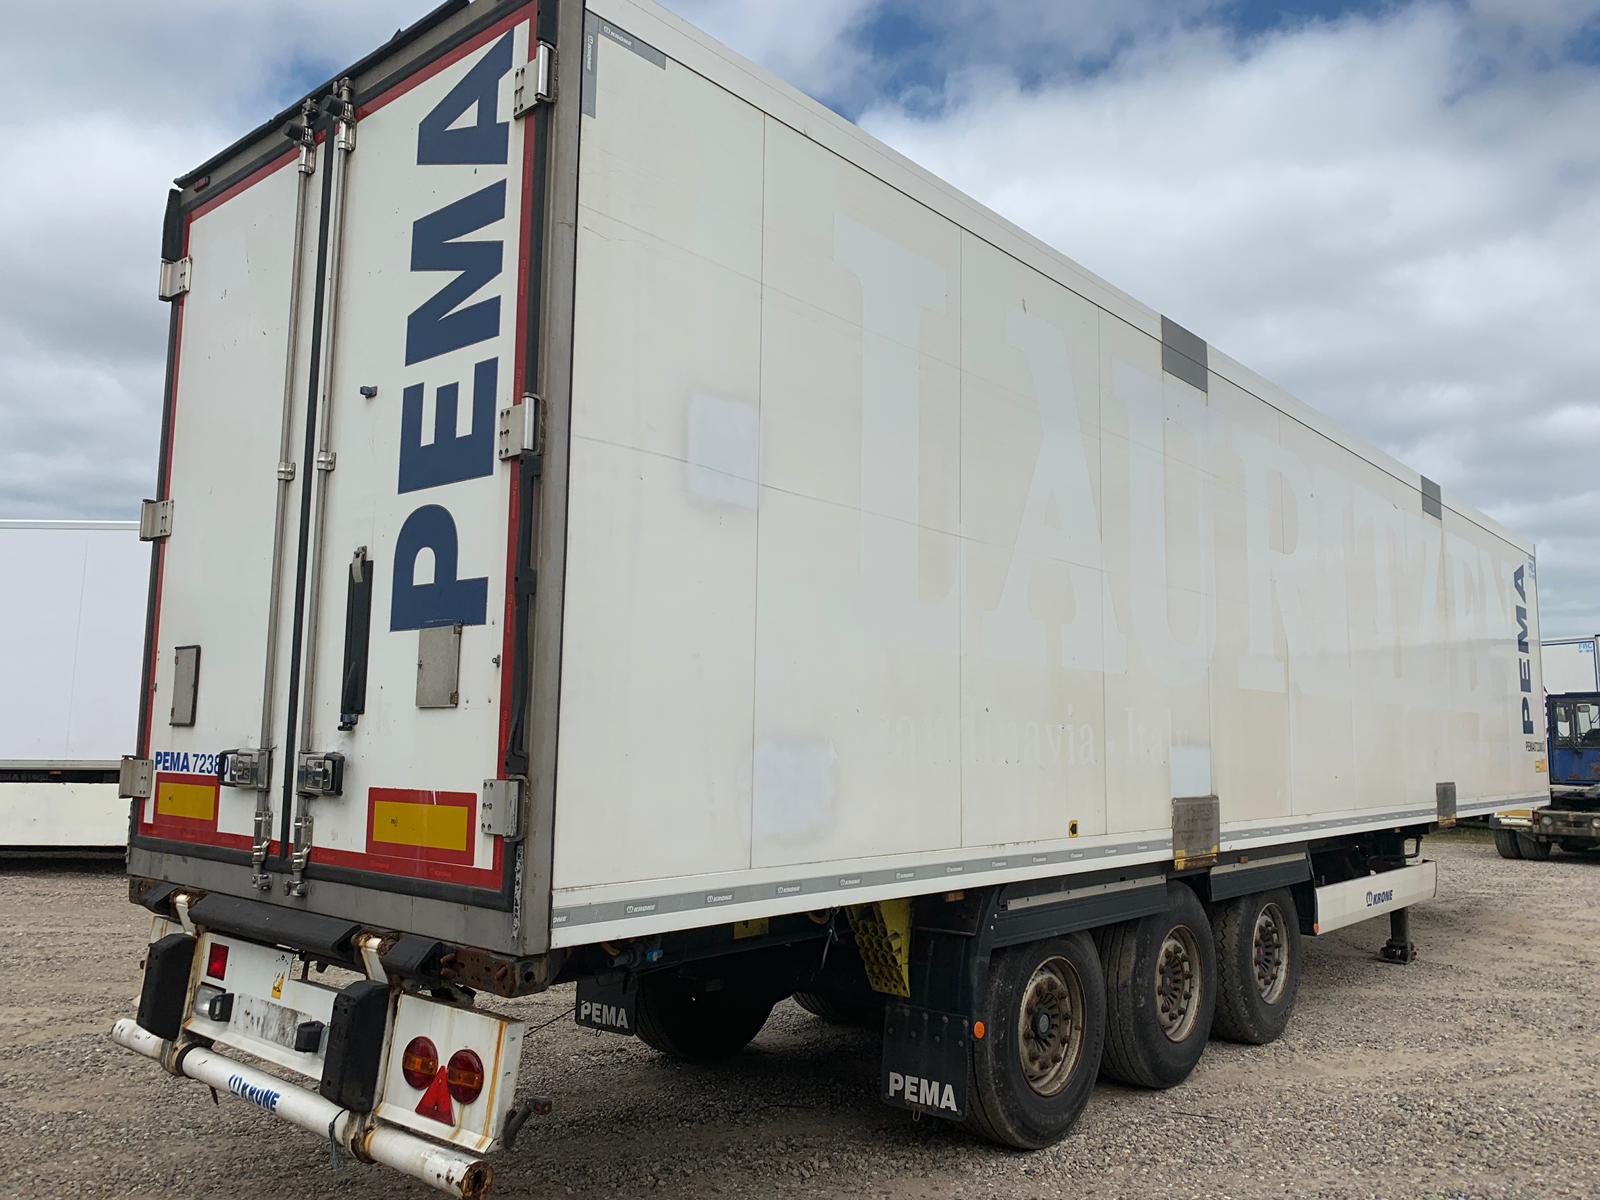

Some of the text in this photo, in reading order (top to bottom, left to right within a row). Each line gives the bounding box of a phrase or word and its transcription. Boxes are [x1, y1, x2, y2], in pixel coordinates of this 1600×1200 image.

[390, 27, 515, 632] PEMA
[1514, 564, 1534, 735] PEMA
[154, 751, 190, 773] PEMA
[633, 904, 656, 913] KRONE
[1373, 890, 1393, 906] KRONE
[581, 1000, 629, 1029] PEMA
[889, 1072, 958, 1112] PEMA
